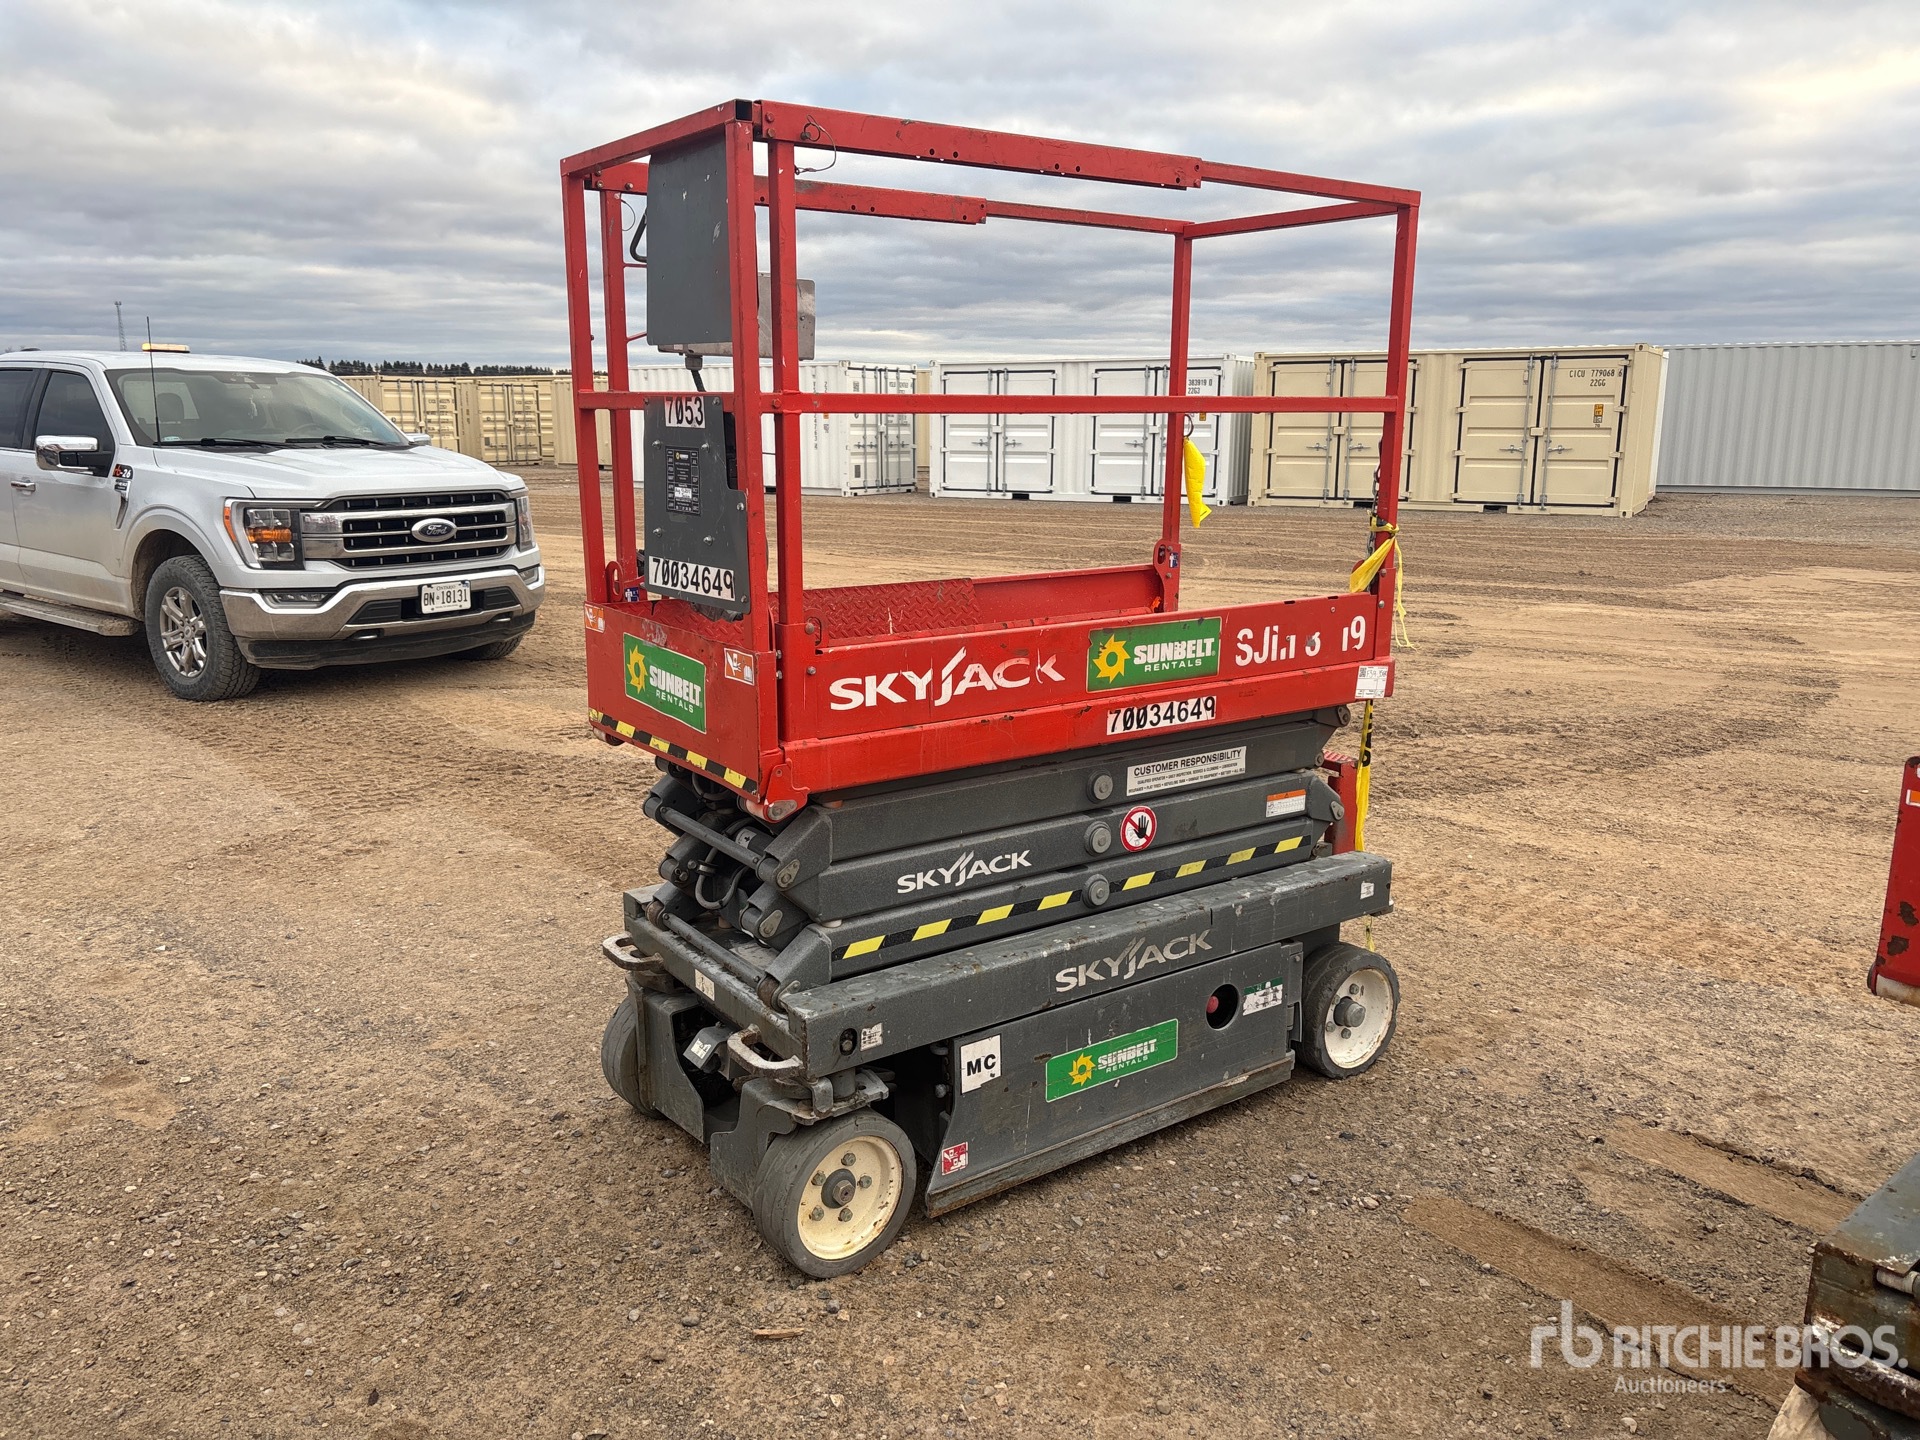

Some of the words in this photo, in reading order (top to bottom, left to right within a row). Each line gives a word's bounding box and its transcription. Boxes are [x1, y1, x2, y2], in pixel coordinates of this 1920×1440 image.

[1569, 370, 1586, 378] CICU
[1591, 369, 1615, 377] 779068
[666, 396, 704, 426] 7053
[426, 524, 447, 535] Ford
[653, 558, 734, 599] 70034649
[424, 592, 435, 606] BN
[441, 588, 468, 605] 18131
[1133, 637, 1214, 665] SUNBELT
[829, 646, 1065, 711] SKYJACK
[1144, 658, 1203, 673] RENTALS
[649, 665, 702, 706] SUNBELT
[656, 689, 694, 713] RENTALS
[1109, 696, 1216, 733] 70034649
[1134, 760, 1179, 776] CUSTOMER
[1180, 749, 1241, 768] RESPONSIBILITY
[897, 849, 1032, 894] SKYJACK
[1055, 929, 1213, 993] SKYJACK
[966, 1054, 997, 1077] MC
[1097, 1039, 1158, 1070] SUNBELT
[1106, 1055, 1149, 1073] RENTALS
